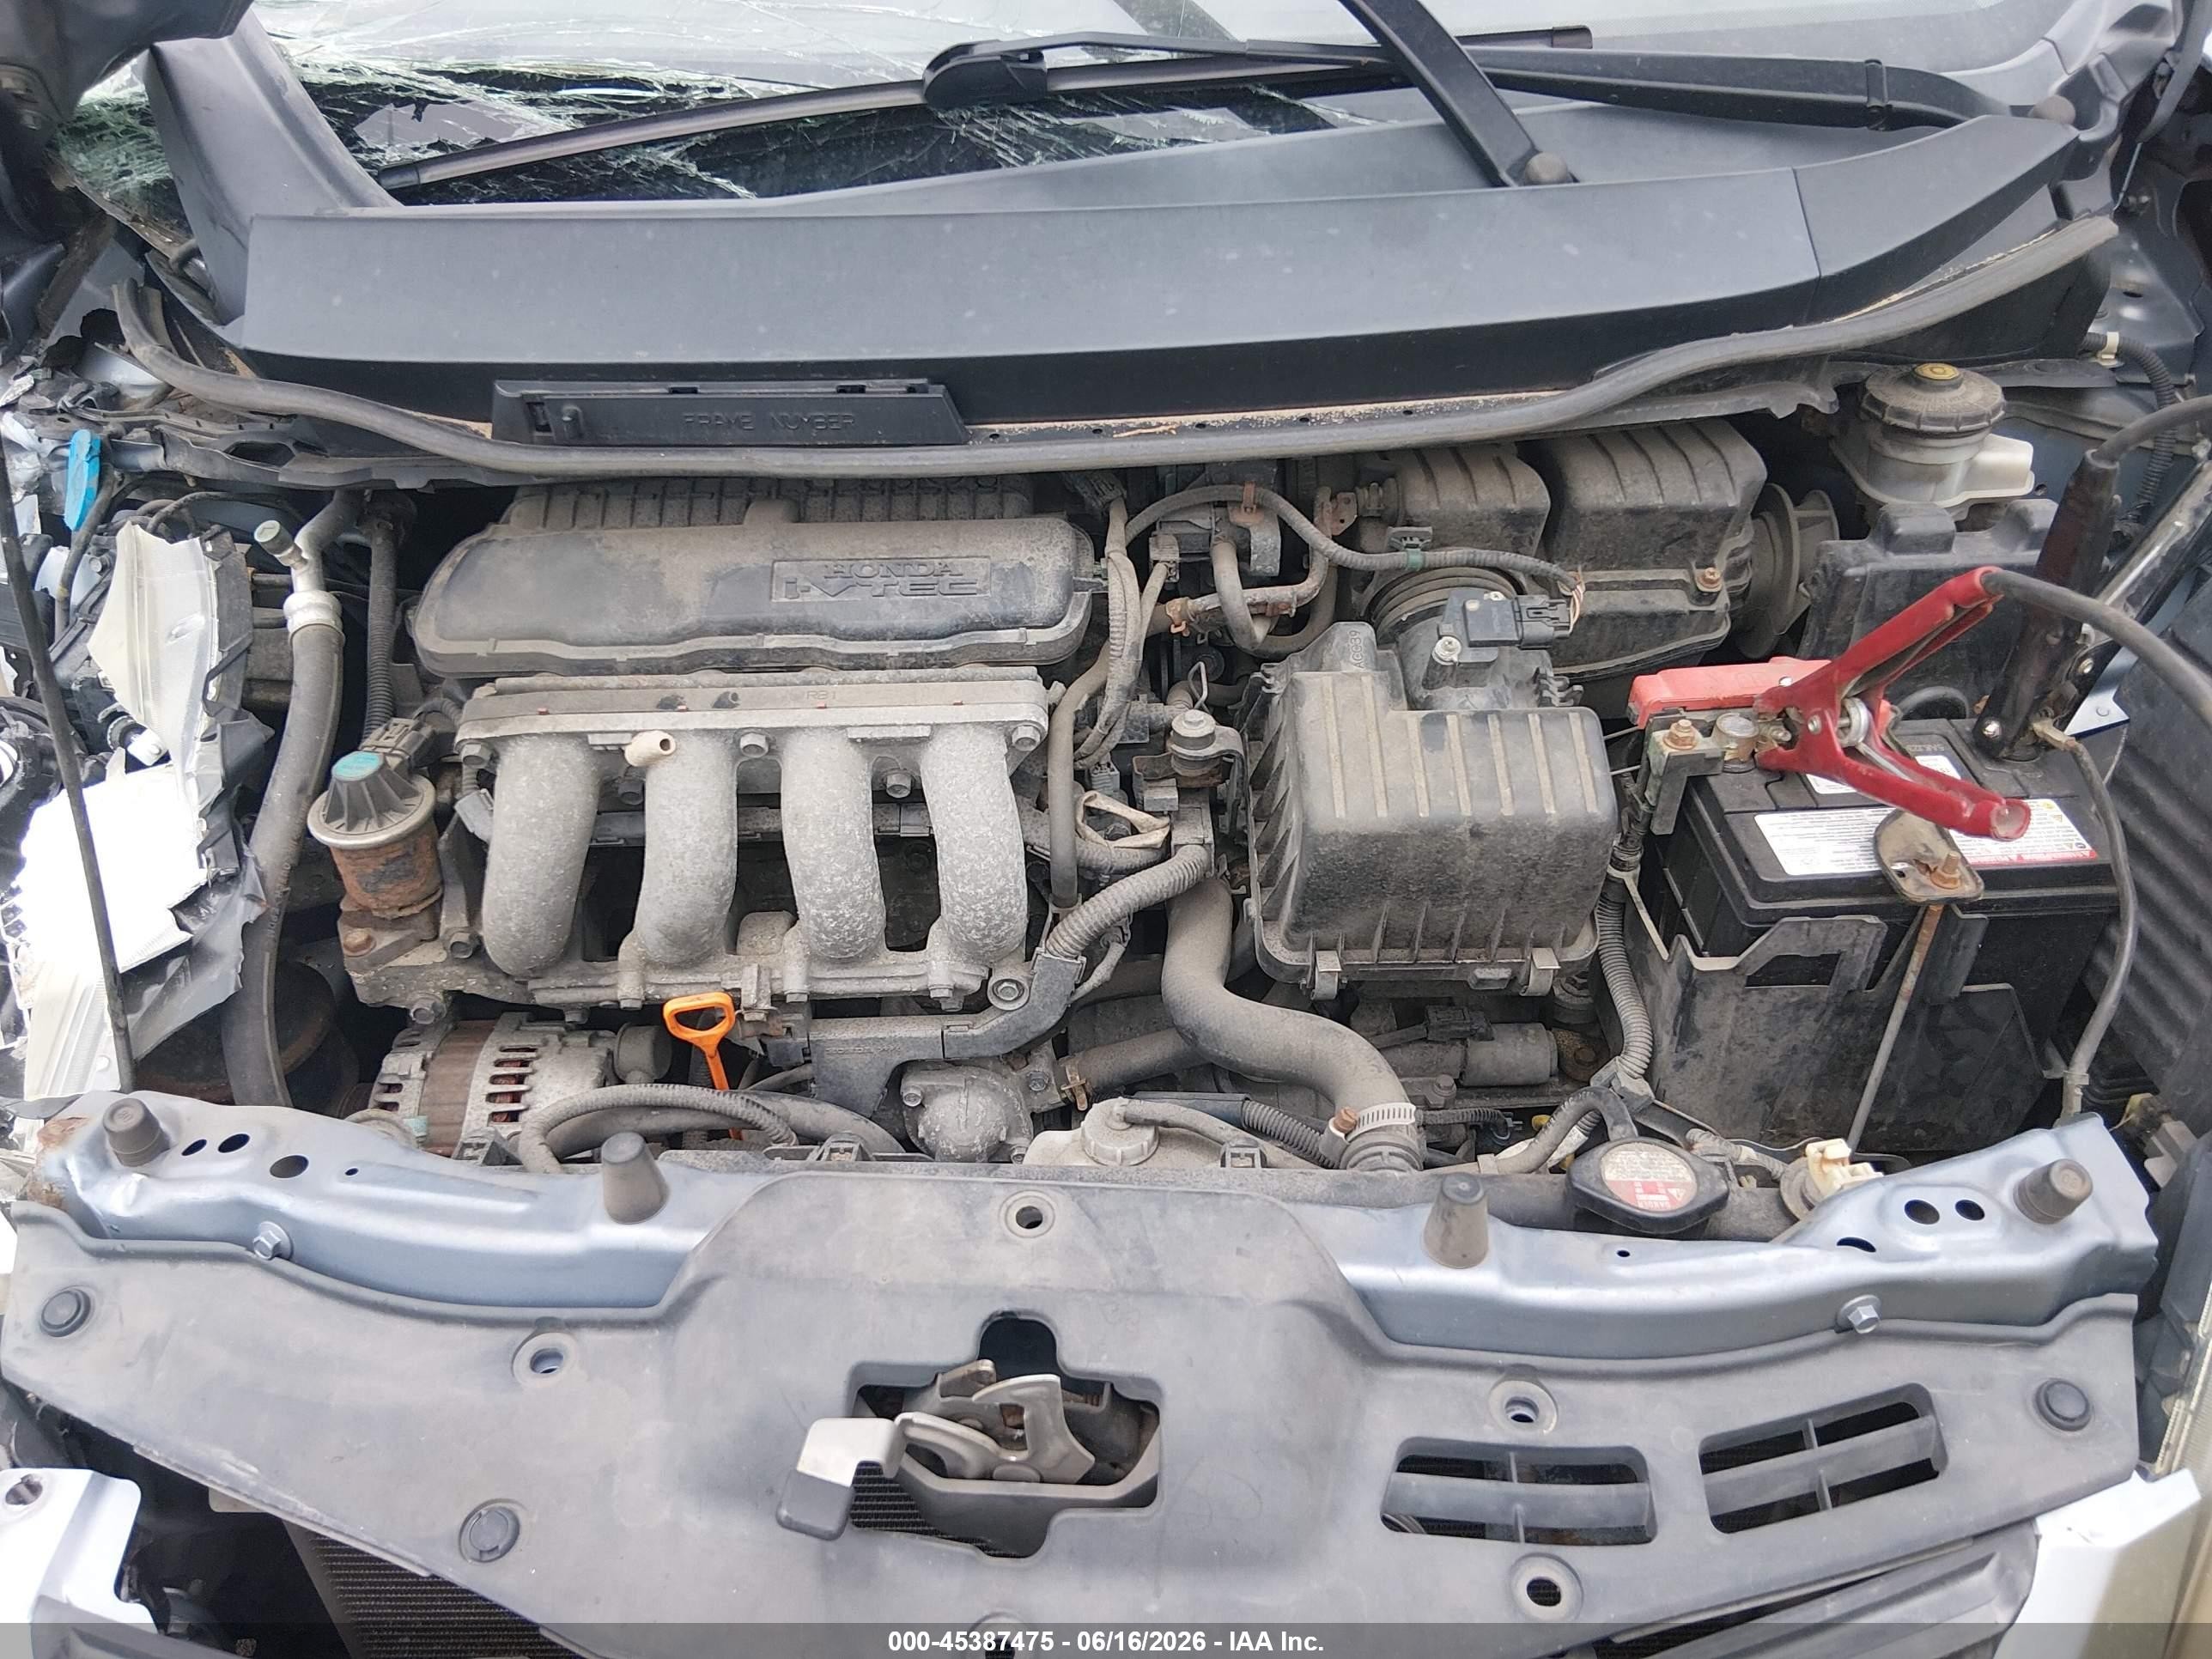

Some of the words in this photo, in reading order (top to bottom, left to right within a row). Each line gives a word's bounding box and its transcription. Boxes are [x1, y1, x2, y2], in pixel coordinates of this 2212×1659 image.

[684, 412, 755, 429] FRAME
[770, 412, 856, 429] NUMBER
[823, 562, 963, 579] HONDA
